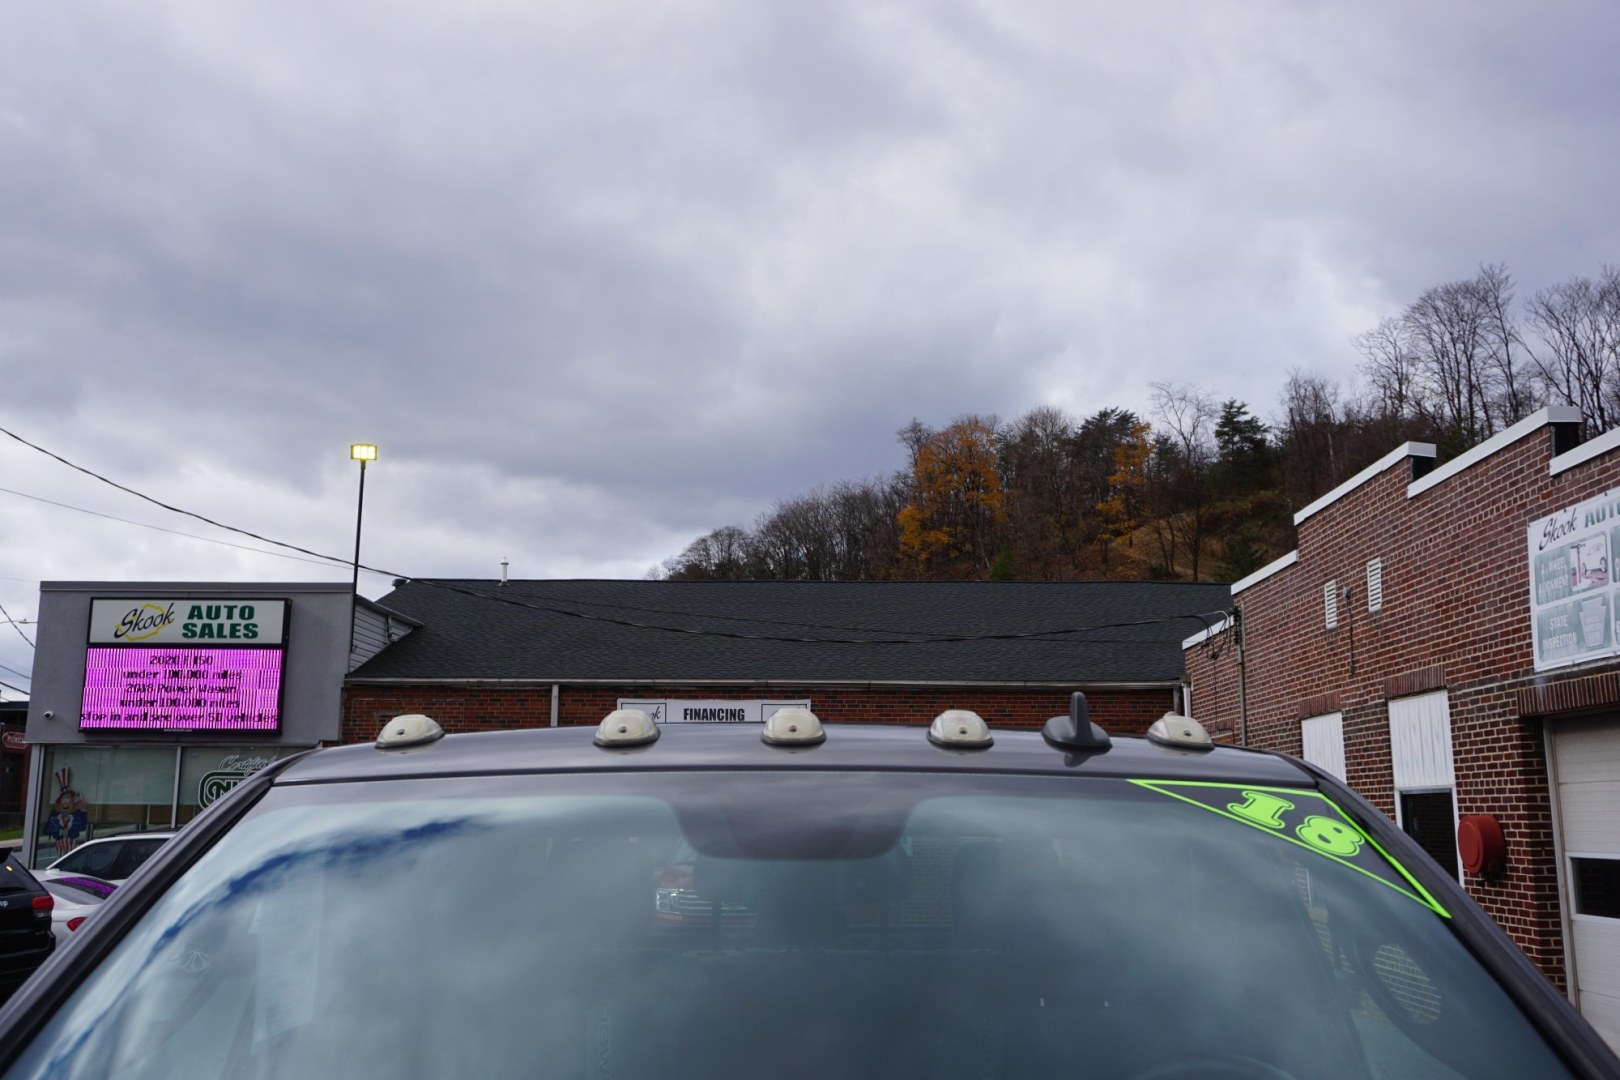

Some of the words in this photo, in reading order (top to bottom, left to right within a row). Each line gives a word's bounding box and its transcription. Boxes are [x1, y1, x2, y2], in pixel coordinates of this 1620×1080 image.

[1539, 507, 1578, 551] Skook
[187, 605, 255, 620] AUTO
[114, 602, 175, 639] Skook
[182, 623, 258, 639] SALES
[123, 669, 160, 679] under
[158, 683, 194, 694] Power
[199, 684, 237, 694] Wagon
[120, 698, 158, 708] under
[210, 698, 240, 709] miles
[110, 712, 122, 721] in
[125, 712, 148, 722] and
[150, 713, 172, 722] see
[176, 714, 204, 722] over
[683, 708, 745, 722] FINANCING
